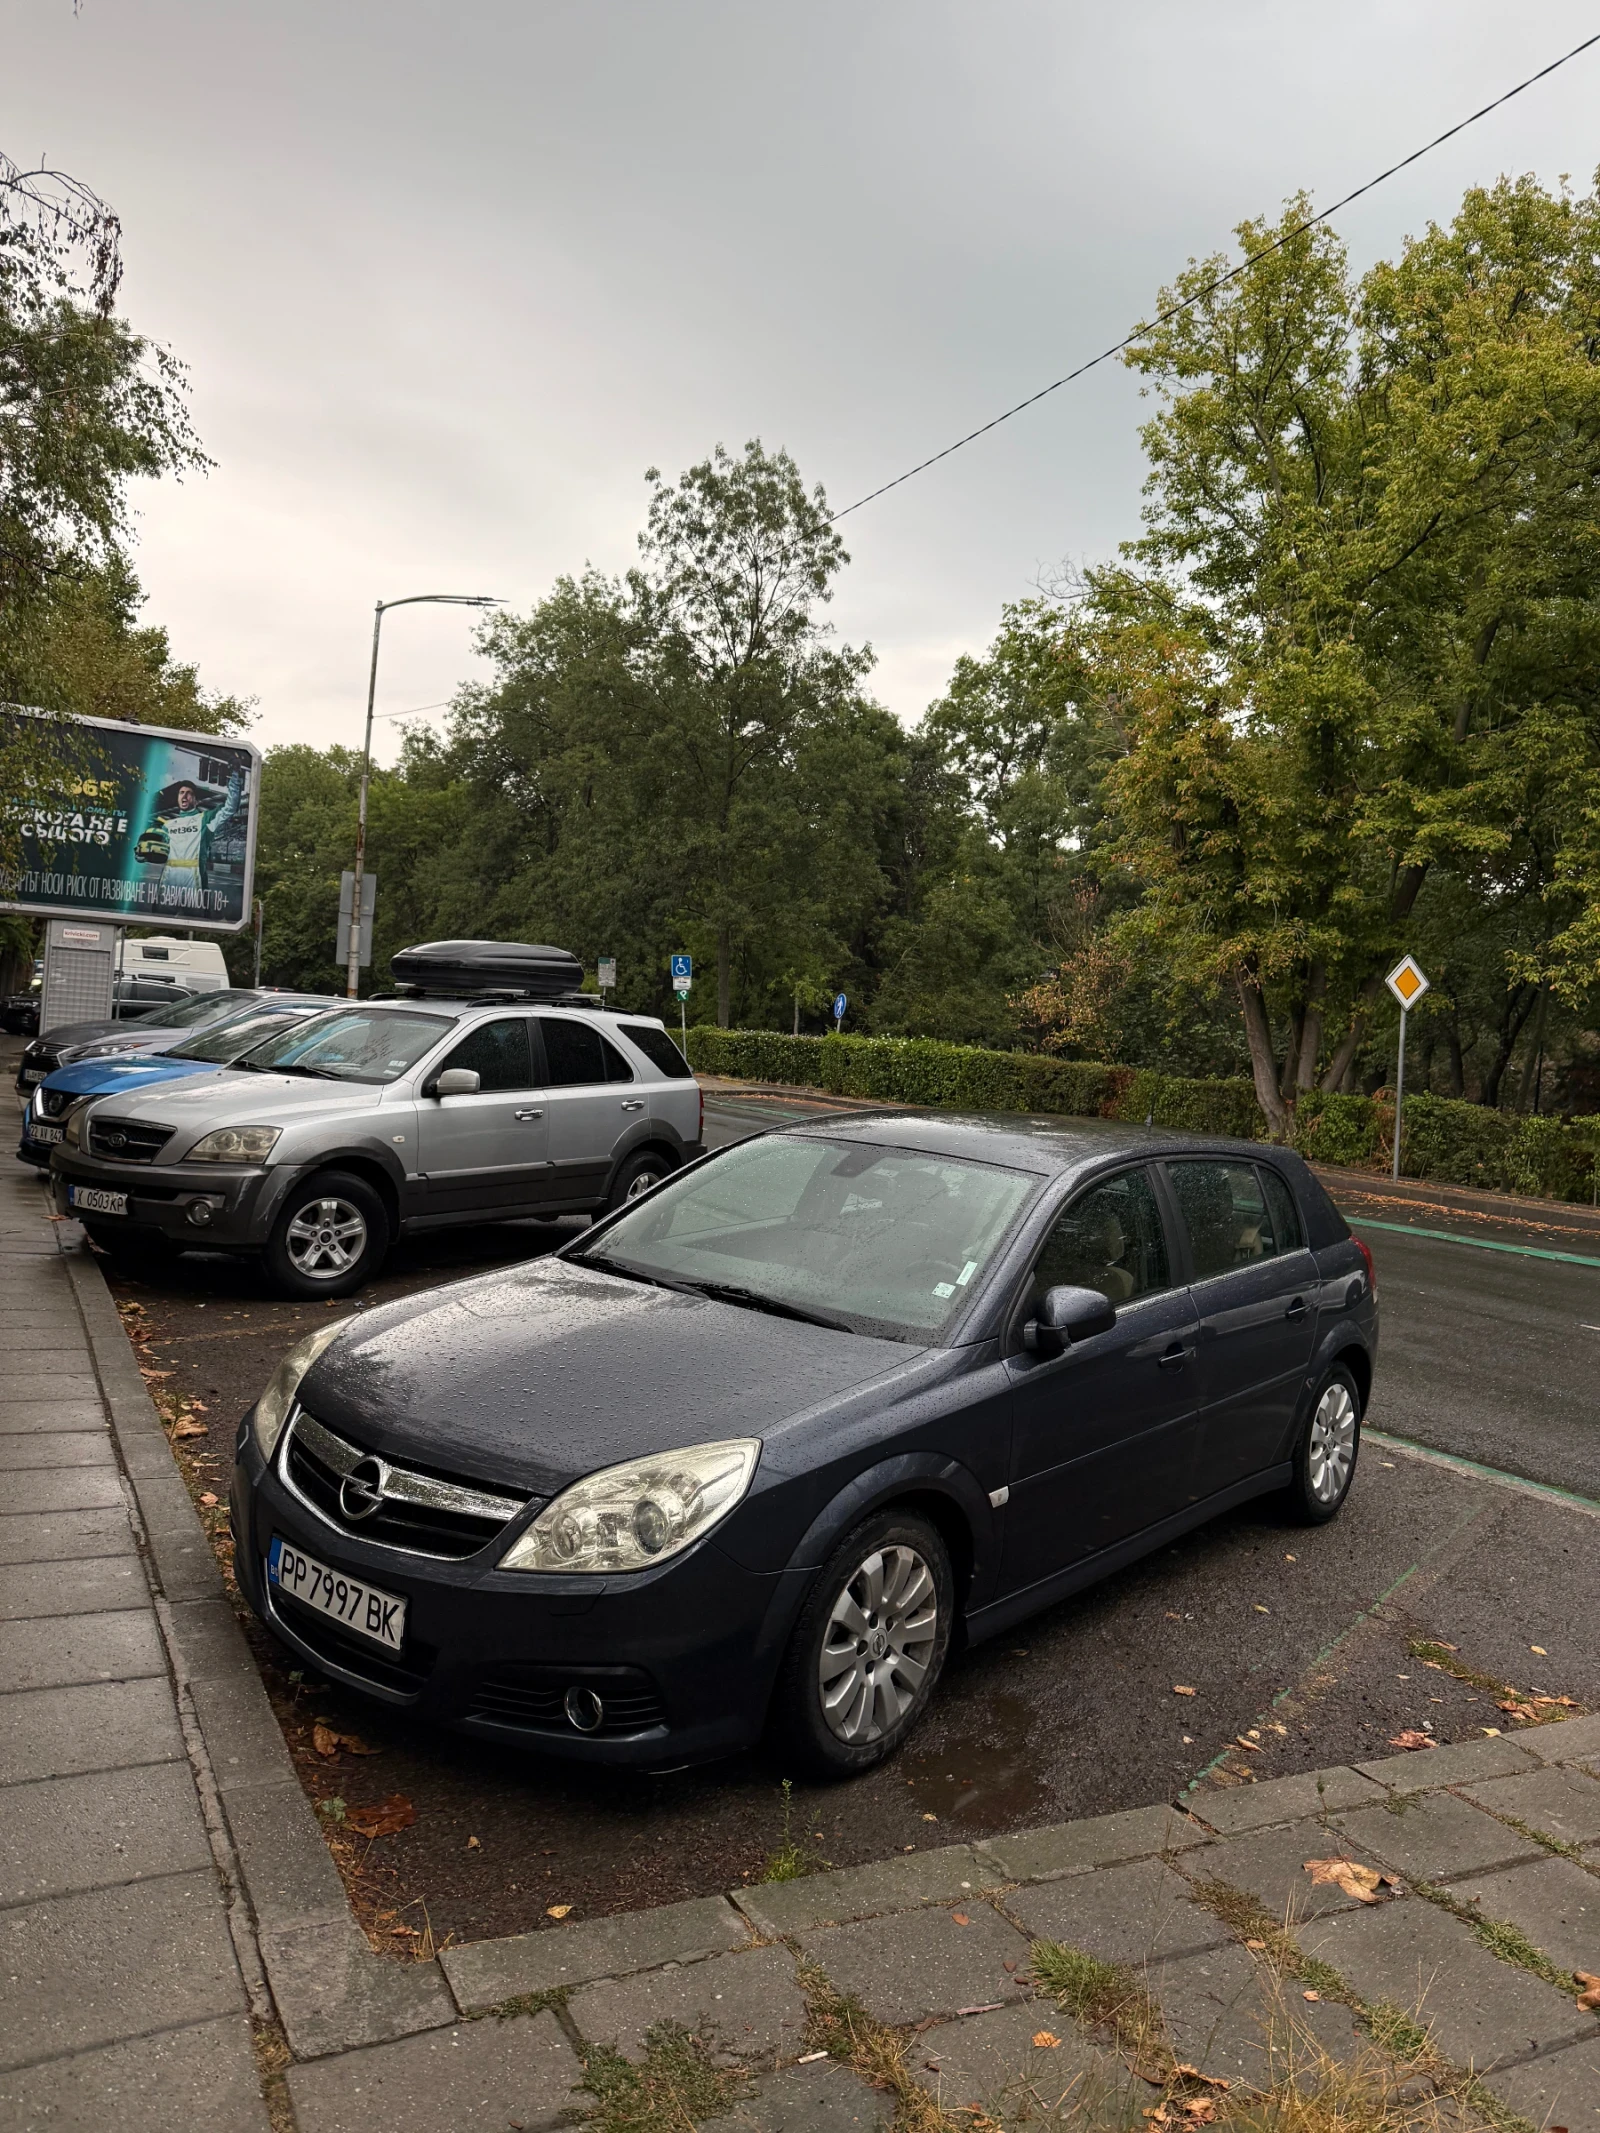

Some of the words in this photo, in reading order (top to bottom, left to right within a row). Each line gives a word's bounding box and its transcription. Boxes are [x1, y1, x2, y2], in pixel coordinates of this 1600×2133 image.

[80, 805, 127, 818] ОМЕТЪТ
[20, 823, 110, 845] СЪЩОТО
[117, 819, 128, 833] Е
[41, 871, 64, 895] НОСИ
[66, 874, 88, 897] РИСК
[89, 877, 101, 899] ОТ
[101, 878, 146, 903] РАЗВИВАНЕ
[147, 882, 159, 905] НА
[160, 885, 212, 910] ЗАВИСИМОСТ
[213, 890, 229, 911] 18+
